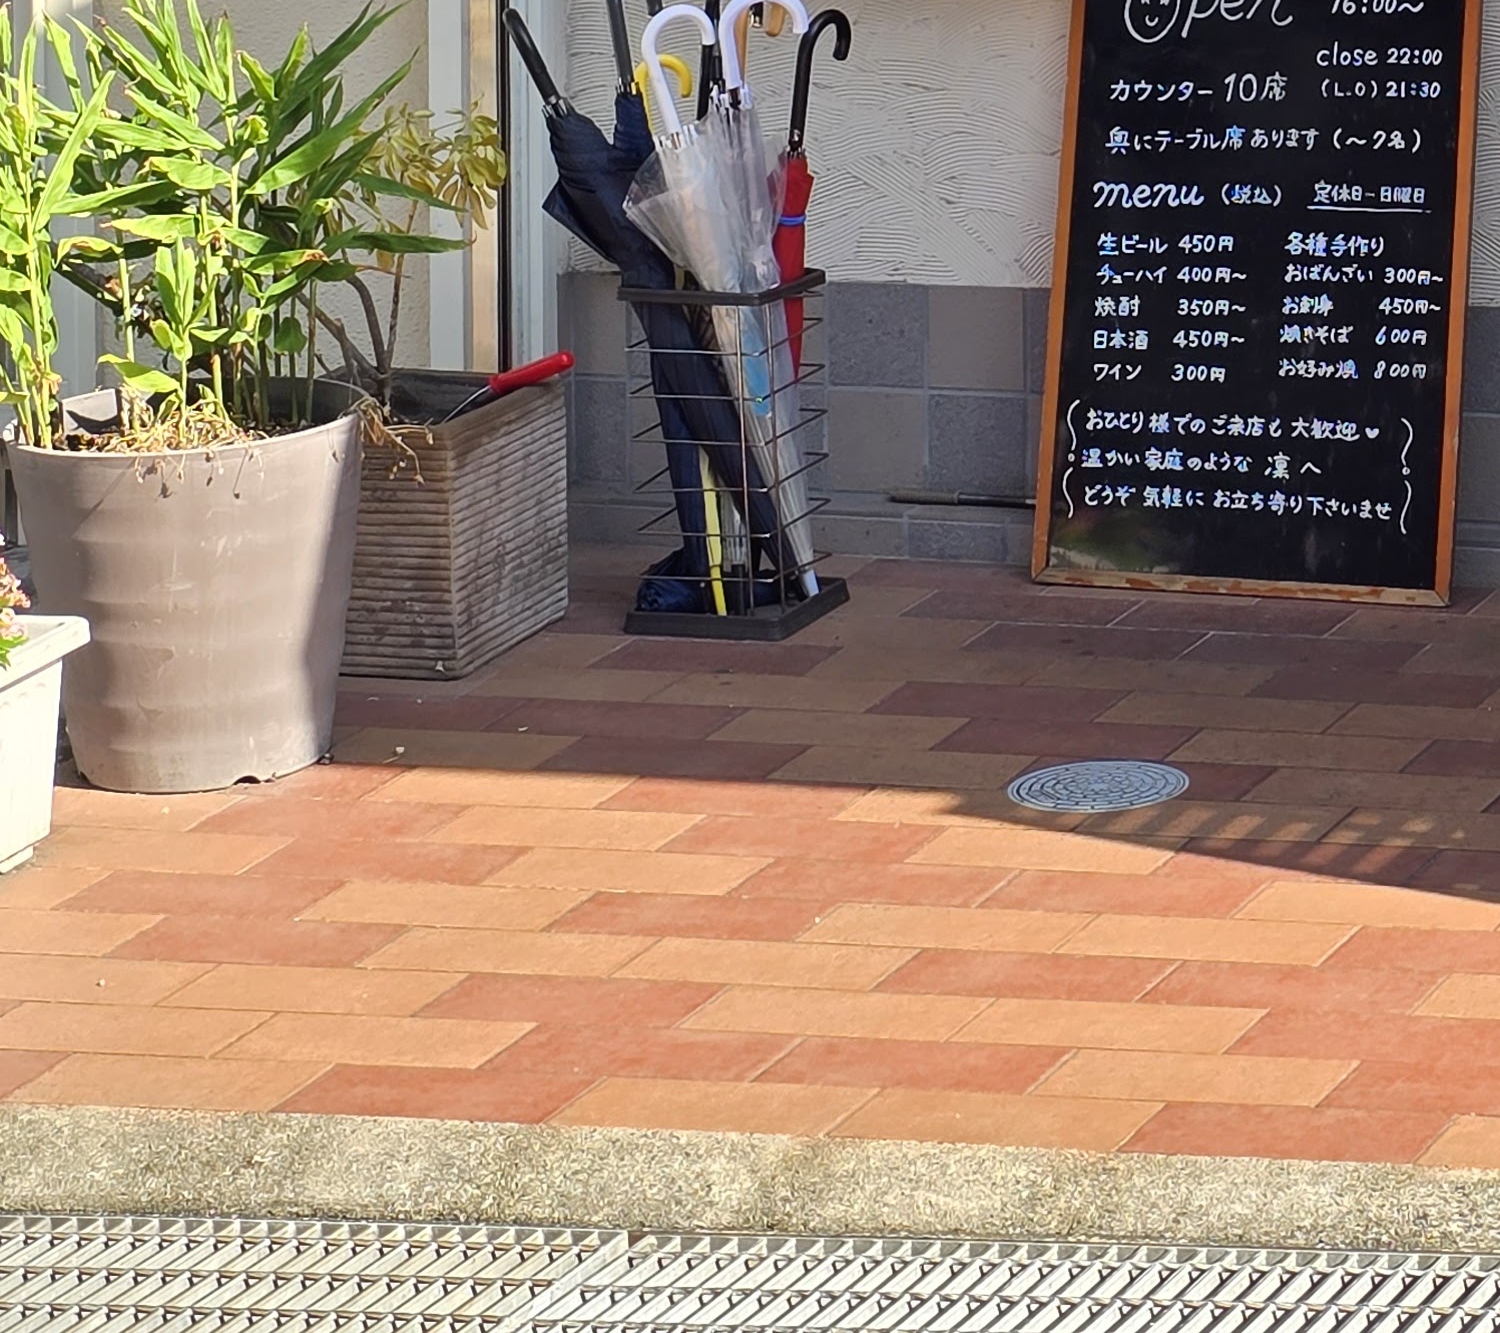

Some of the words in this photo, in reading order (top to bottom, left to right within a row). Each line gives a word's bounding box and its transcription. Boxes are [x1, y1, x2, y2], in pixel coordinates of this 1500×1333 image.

[1317, 41, 1378, 66] close
[1387, 48, 1442, 65] 22:00
[1110, 80, 1213, 101] カウンター
[1225, 72, 1287, 102] 10席
[1386, 82, 1440, 98] 21:30
[1093, 182, 1204, 208] menu
[1097, 232, 1168, 255] 生ビール
[1178, 235, 1233, 253] 450円
[1285, 232, 1383, 257] 各種手作り
[1096, 264, 1167, 284] チューハイ
[1285, 264, 1372, 282] おばんざい
[1095, 295, 1140, 316] 焼酎
[1094, 329, 1148, 349] 日本酒
[1375, 326, 1427, 345] 600円
[1094, 364, 1141, 381] ワイン
[1171, 364, 1225, 383] 300円
[1374, 361, 1426, 379] 800円
